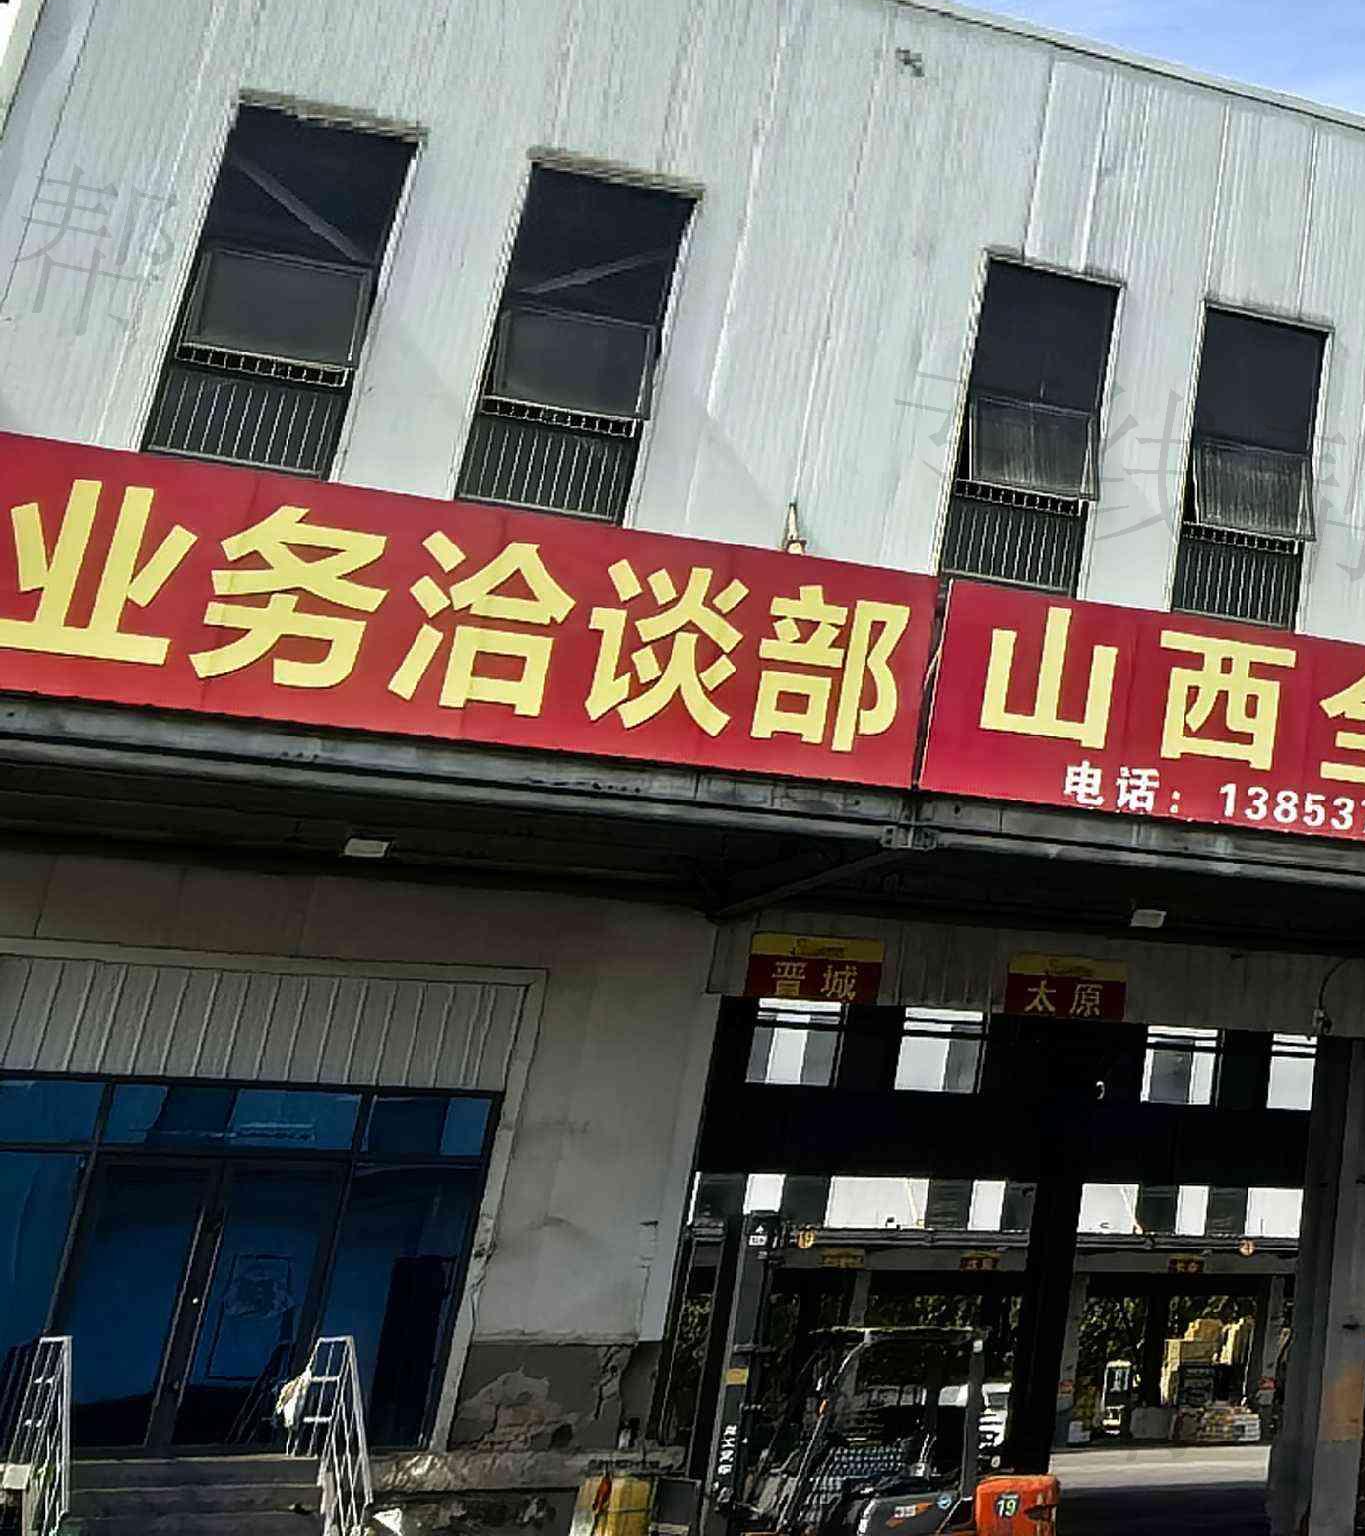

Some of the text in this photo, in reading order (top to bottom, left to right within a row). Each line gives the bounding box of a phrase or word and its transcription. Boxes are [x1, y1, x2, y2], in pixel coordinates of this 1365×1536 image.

[0, 479, 912, 753] 业务洽谈部
[771, 961, 858, 1000] 晋城
[1024, 979, 1103, 1017] 太原
[997, 1499, 1016, 1517] 19
